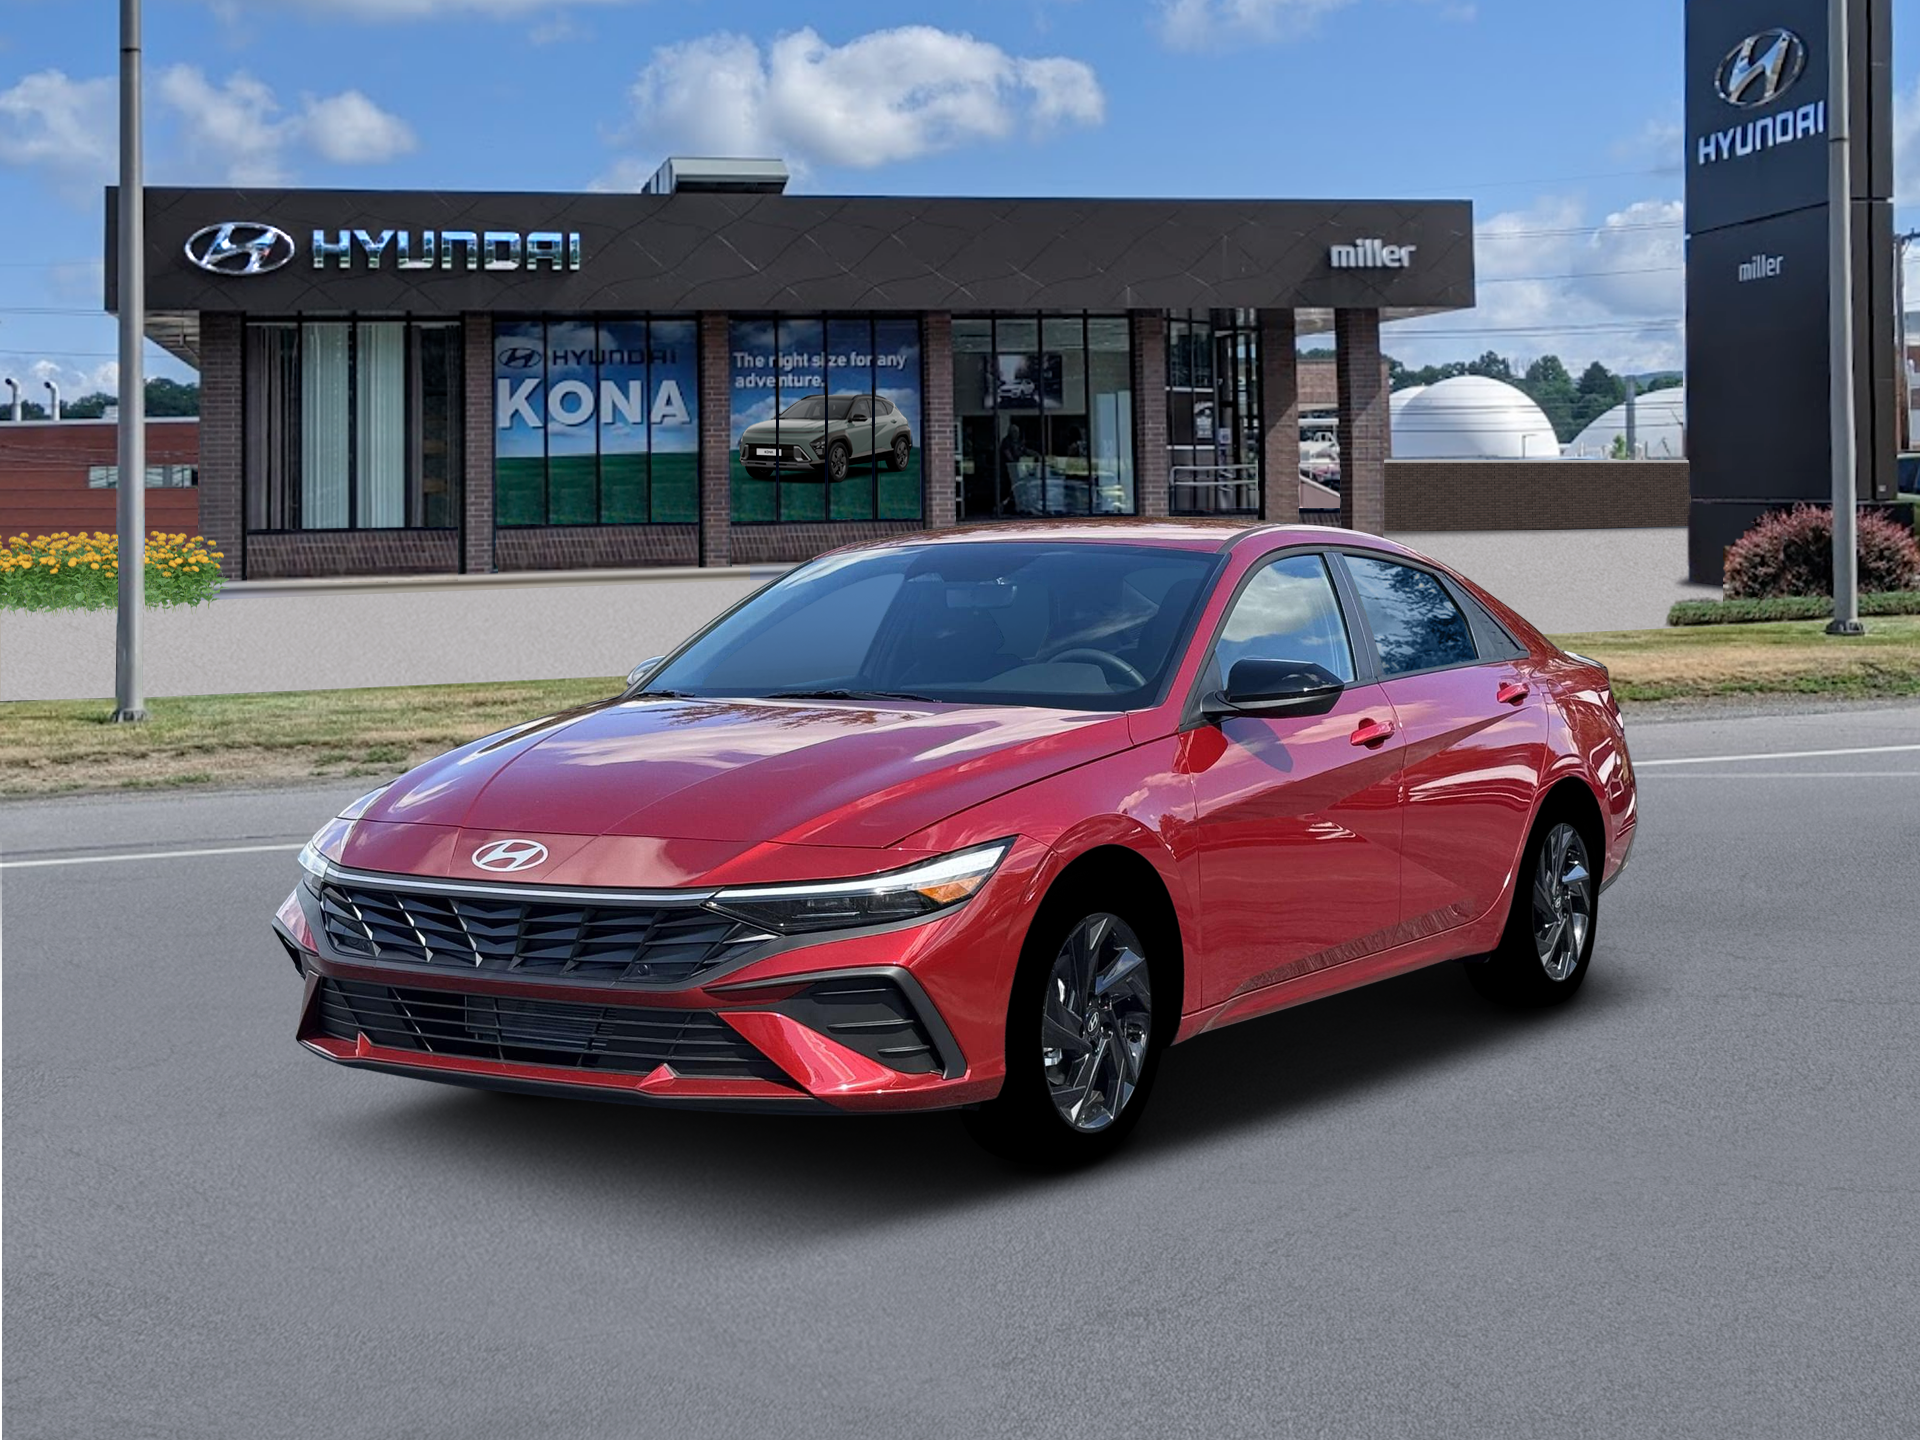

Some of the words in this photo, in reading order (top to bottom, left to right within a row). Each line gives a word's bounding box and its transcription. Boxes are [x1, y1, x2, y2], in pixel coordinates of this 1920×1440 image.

[1698, 101, 1825, 165] HYUNDAI
[313, 229, 580, 270] HYUNDAI
[1330, 238, 1417, 268] miller
[1739, 254, 1784, 282] miller
[552, 350, 677, 366] HYUNDAI
[733, 352, 765, 368] The
[768, 352, 809, 372] right
[811, 352, 847, 367] size
[850, 351, 873, 367] for
[877, 354, 907, 370] any
[735, 373, 825, 388] adventure.
[497, 378, 690, 428] KONA
